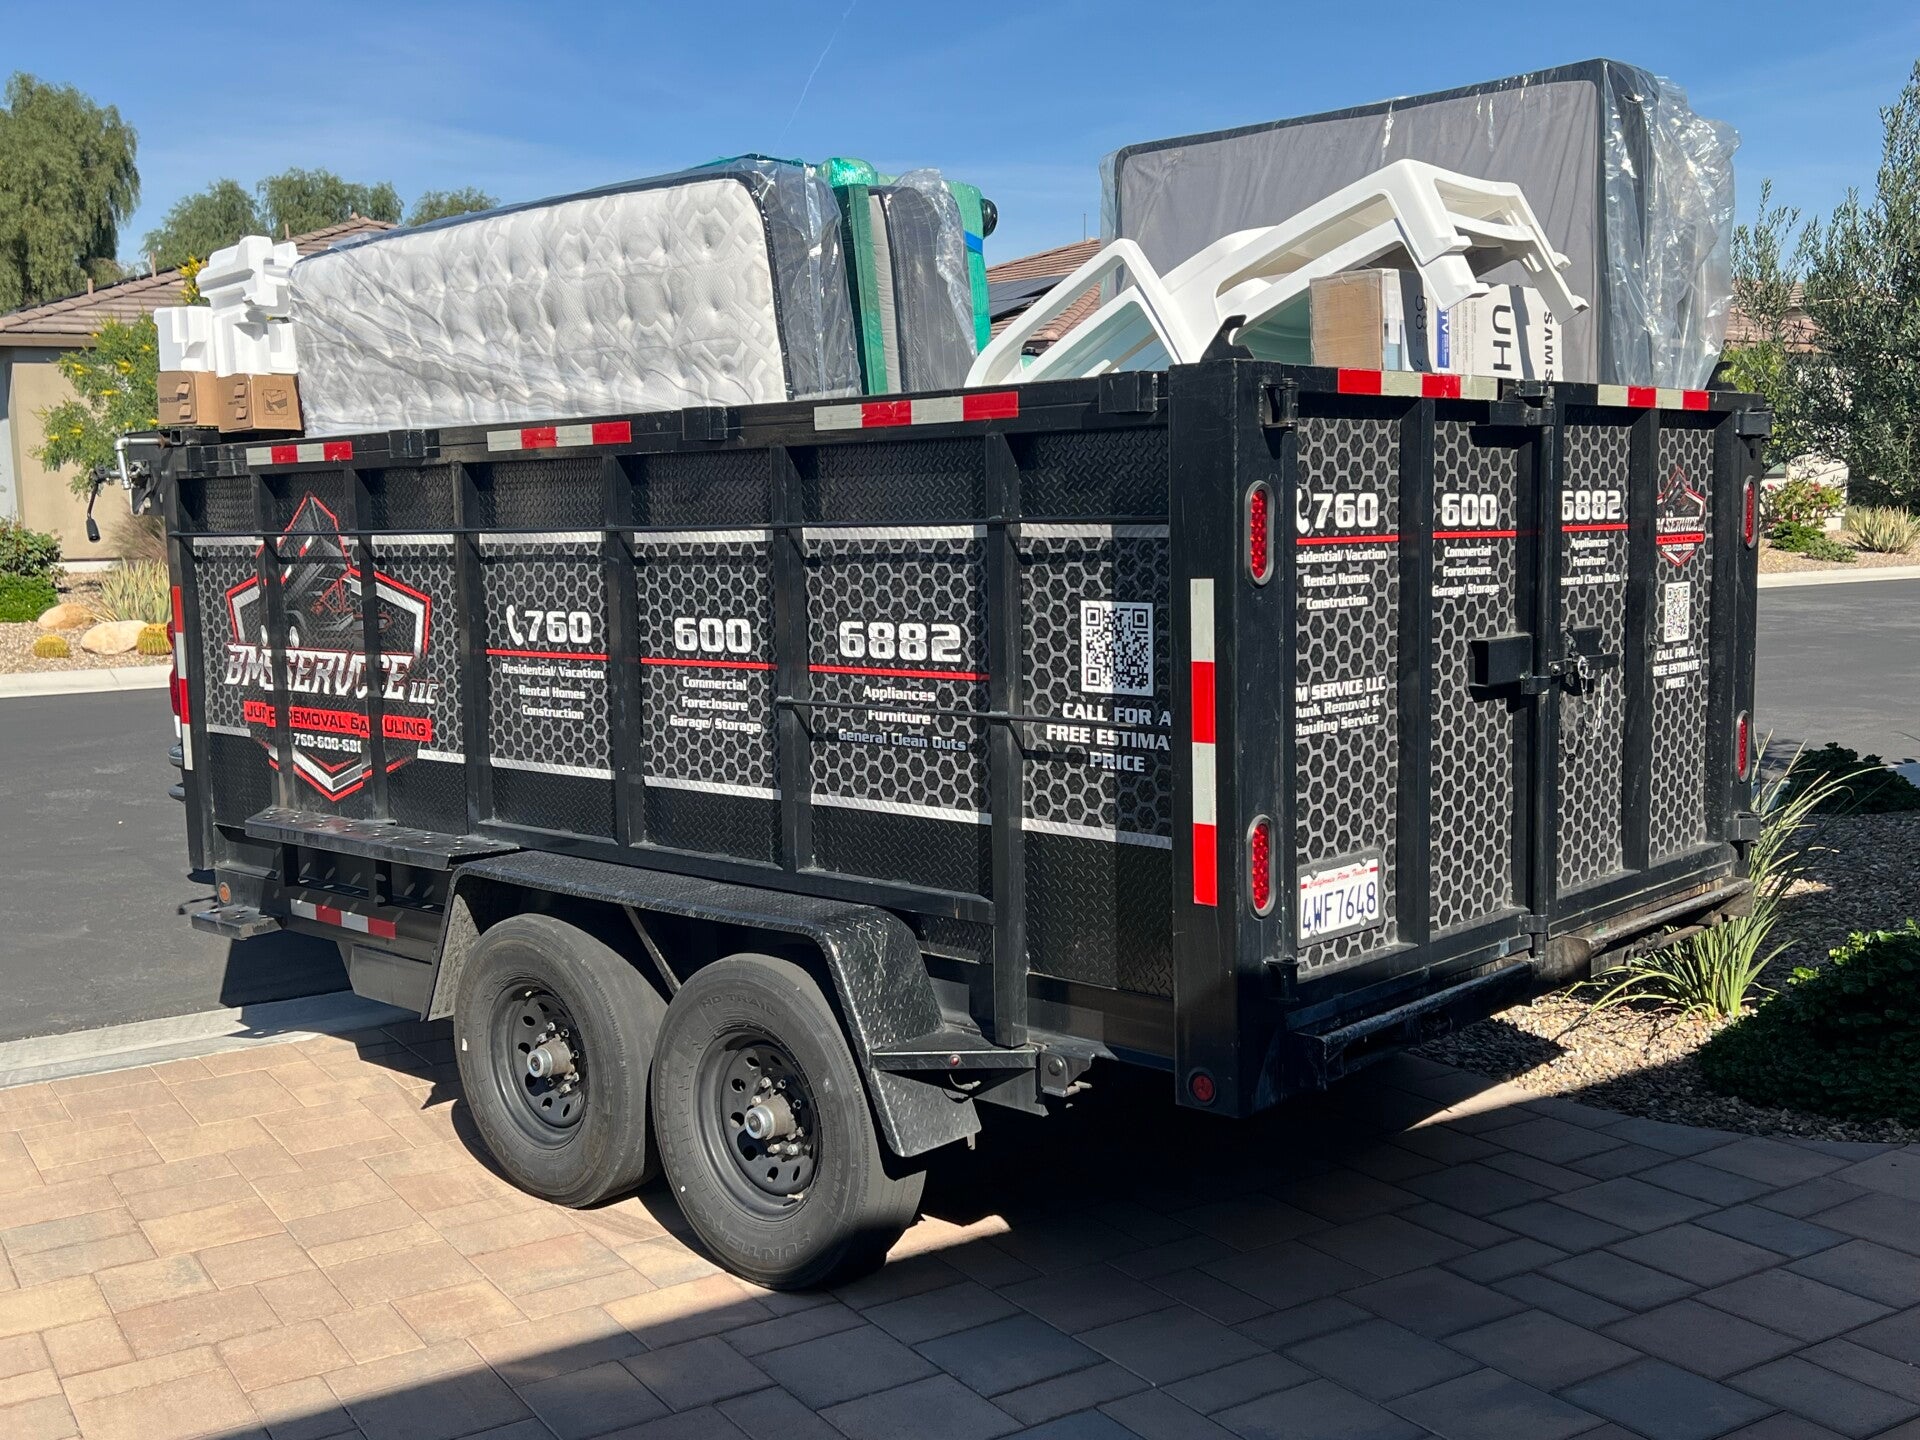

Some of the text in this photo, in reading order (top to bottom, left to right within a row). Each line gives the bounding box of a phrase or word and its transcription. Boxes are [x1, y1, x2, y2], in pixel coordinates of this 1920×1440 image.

[1492, 304, 1512, 371] UH
[1544, 311, 1554, 381] SAMS
[1313, 490, 1621, 529] 760 600 6882
[1444, 545, 1492, 558] Commercial
[1570, 537, 1609, 550] Appliances
[1296, 549, 1386, 564] sidential/ Vacation
[1573, 555, 1606, 567] Furniture
[1303, 572, 1370, 587] Rental Homes
[1443, 565, 1492, 578] Foreclosure
[1560, 572, 1621, 586] eneral Clean Outs
[1467, 582, 1500, 596] Storage
[1306, 596, 1368, 610] Construction
[524, 610, 962, 662] 760 600 6882
[1656, 645, 1695, 661] CALL FOR A
[557, 666, 605, 680] Vacation
[1668, 659, 1700, 675] ESTIMATE
[682, 676, 748, 691] Commercial
[1295, 675, 1386, 703] M SERVICE LLC
[1665, 676, 1686, 690] PRICE
[409, 681, 439, 704] LLC
[518, 684, 586, 700] Rental Homes
[862, 685, 937, 702] Appliances
[681, 696, 749, 711] Foreclosure
[1323, 698, 1370, 715] Removal
[1371, 694, 1381, 708] &
[521, 704, 585, 720] Construction
[867, 709, 931, 725] Furniture
[1062, 702, 1172, 727] CALL FOR A
[714, 717, 762, 735] Storage
[1340, 713, 1380, 730] Service
[838, 728, 967, 751] General Clean Outs
[1046, 724, 1172, 751] FREE ESTIMA
[1089, 751, 1145, 772] PRICE
[1302, 881, 1376, 932] 4WF7648
